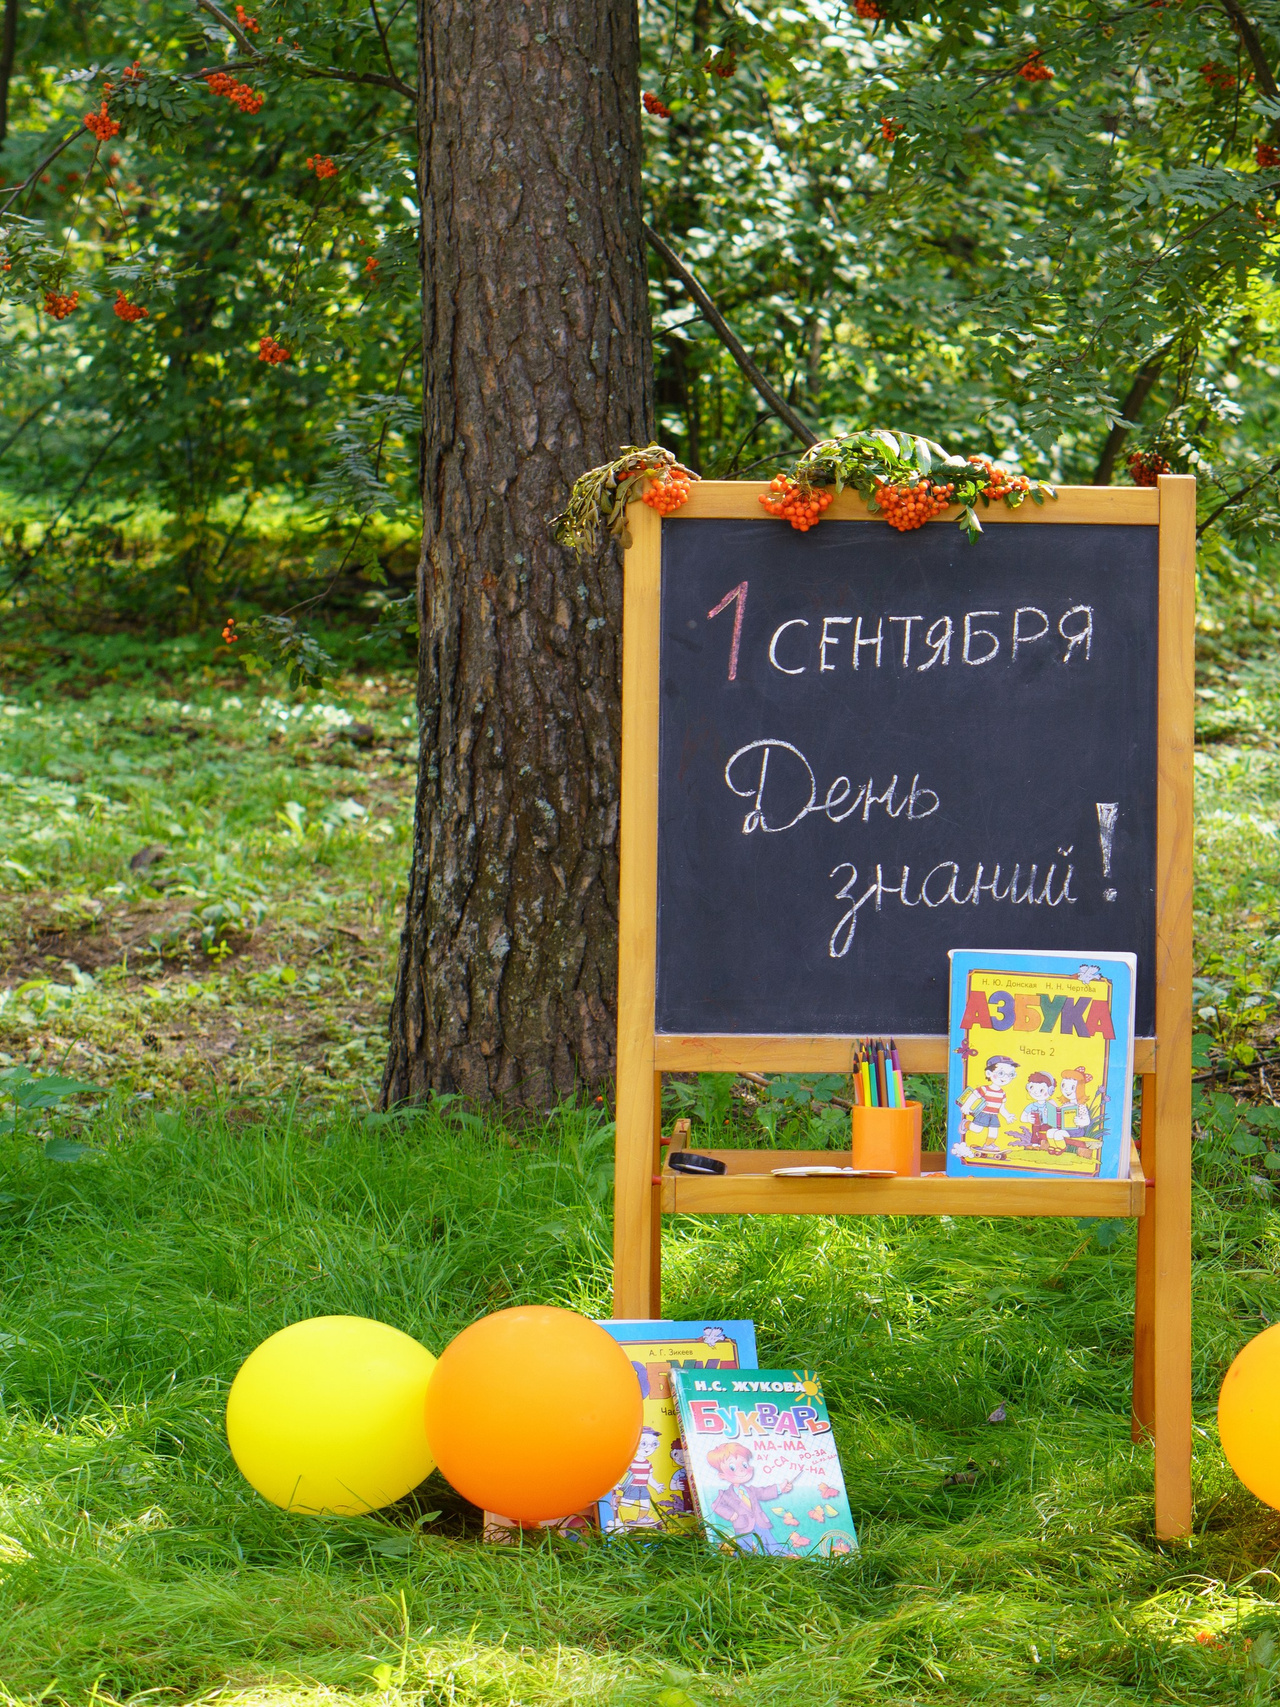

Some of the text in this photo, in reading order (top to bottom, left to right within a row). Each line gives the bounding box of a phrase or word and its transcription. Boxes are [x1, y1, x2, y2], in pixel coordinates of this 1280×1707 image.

[706, 581, 1096, 681] 1 СЕНТЯБРЯ
[724, 738, 941, 836] День
[981, 978, 990, 986] Н.
[1006, 979, 1037, 989] Донская
[1045, 982, 1054, 990] Н.
[1056, 983, 1064, 991] Н.
[960, 990, 1116, 1040] АЗБУКА
[1019, 1045, 1056, 1057] Часть 2
[668, 1348, 694, 1356] Зикеев
[694, 1380, 806, 1393] Н.С. ЖУКОВА
[661, 1407, 678, 1416] Час
[753, 1440, 806, 1451] МА-МА
[799, 1448, 827, 1461] РО-ЗА
[762, 1455, 789, 1474] О-СА
[789, 1462, 826, 1476] ЛУ-НА
